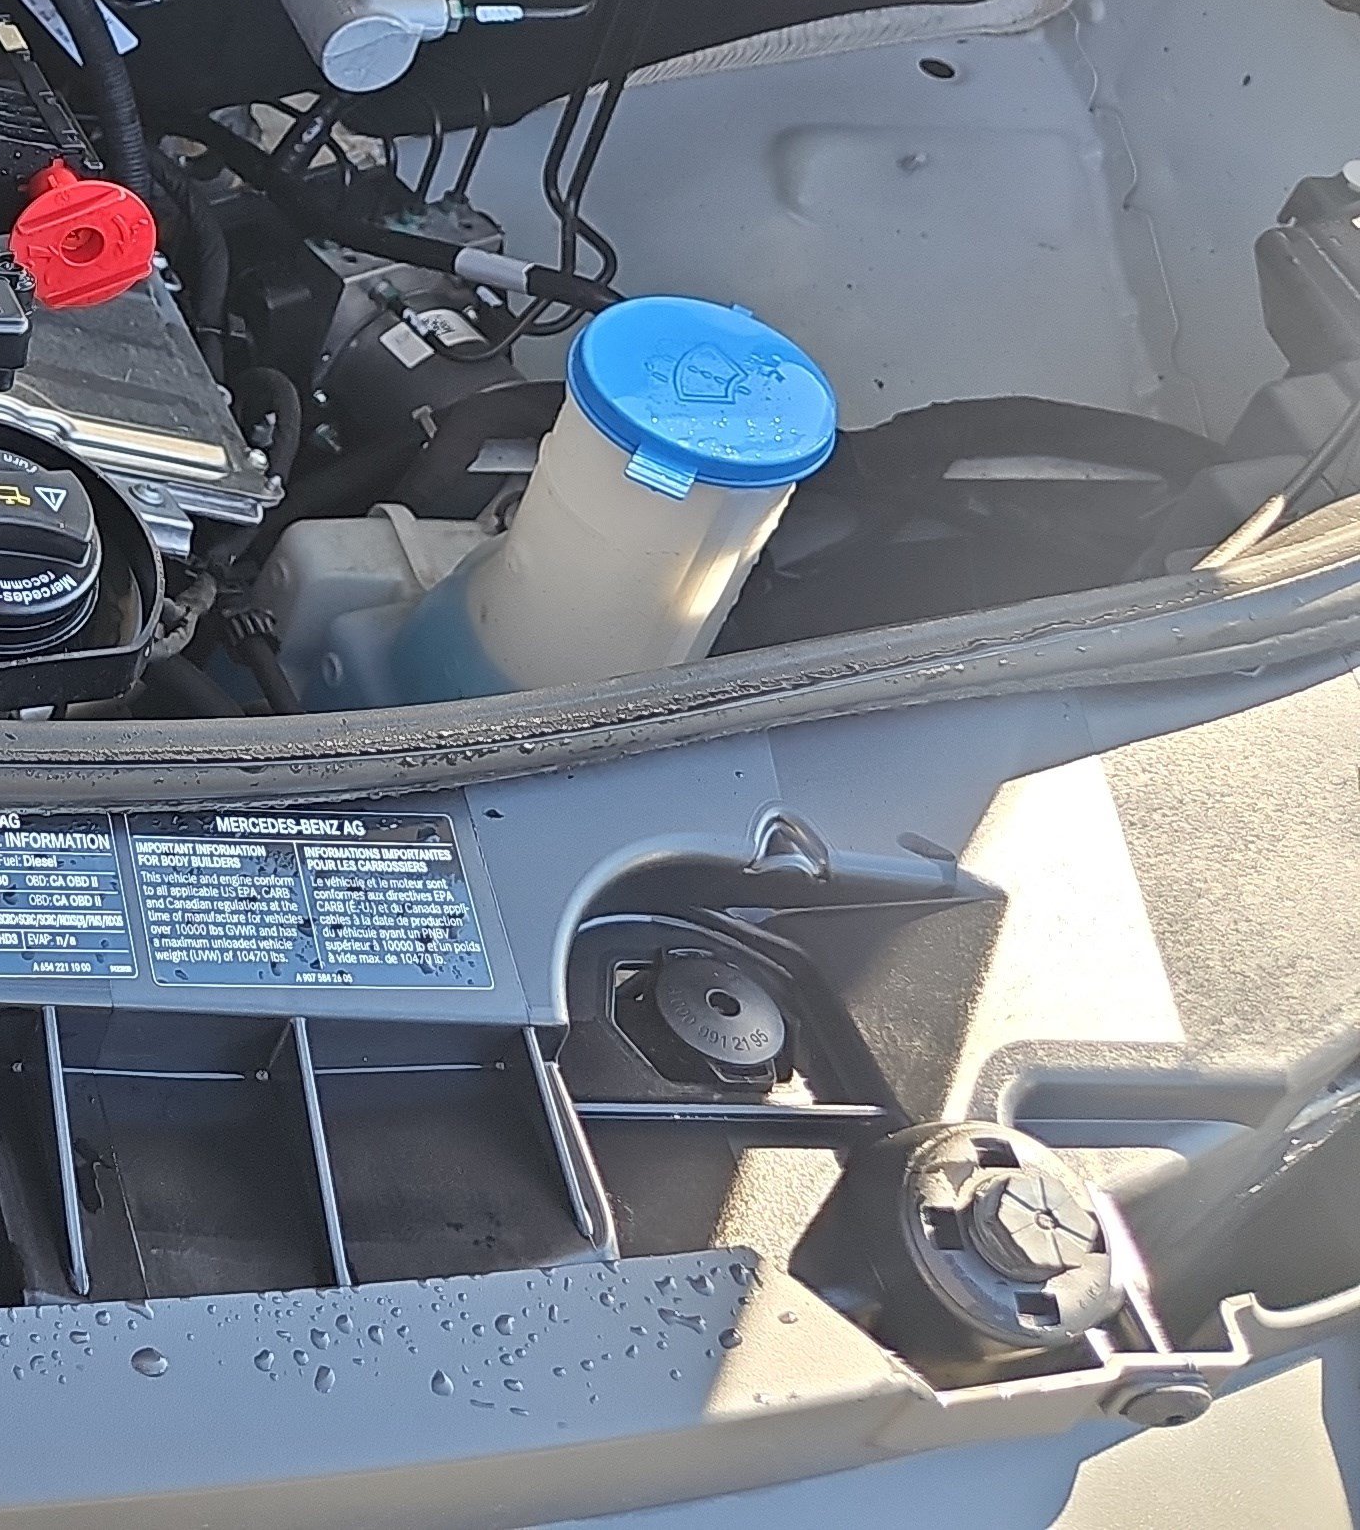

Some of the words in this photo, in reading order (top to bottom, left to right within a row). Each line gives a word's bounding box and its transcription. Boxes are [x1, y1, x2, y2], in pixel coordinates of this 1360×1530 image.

[0, 814, 21, 828] AG
[216, 817, 341, 835] MERCEDES-BENZ
[344, 821, 366, 836] AG
[5, 832, 110, 849] INFORMATION
[136, 842, 194, 855] IMPORTANT
[195, 843, 266, 857] INFORMATION
[304, 847, 380, 859] INFORMATIONS
[382, 848, 452, 861] IMPORTANTES
[23, 855, 58, 868] Diesel
[138, 855, 159, 866] FOR
[161, 855, 189, 867] BODY
[191, 857, 241, 868] BUILDERS
[307, 860, 336, 870] POUR
[338, 860, 356, 871] LES
[358, 861, 428, 873] CARROSSIERS
[141, 871, 161, 882] This
[163, 872, 197, 884] vehicle
[199, 874, 218, 884] and
[220, 874, 252, 886] engine
[254, 874, 294, 886] conform
[143, 886, 154, 895] to
[157, 885, 168, 896] all
[170, 887, 219, 898] applicable
[220, 887, 235, 897] US
[238, 888, 260, 899] EPA,
[262, 888, 290, 898] CARB
[146, 898, 164, 908] and
[166, 898, 212, 909] Canadian
[214, 900, 268, 912] regulations
[270, 902, 279, 910] at
[281, 901, 298, 911] the
[148, 911, 170, 920] time
[172, 911, 182, 921] of
[185, 912, 245, 922] manufacture
[248, 913, 262, 923] for
[263, 913, 304, 924] vehicles
[151, 926, 171, 934] over
[176, 924, 206, 935] 10000
[209, 925, 224, 936] lbs
[226, 925, 256, 936] GVWR
[259, 926, 278, 936] and
[280, 927, 298, 937] has
[161, 938, 209, 948] maximum
[212, 938, 257, 949] unloaded
[258, 938, 293, 949] vehicle
[155, 951, 188, 963] weight
[190, 951, 221, 963] (UVW)
[223, 952, 233, 961] of
[237, 951, 268, 962] 10470
[270, 952, 288, 963] lbs.
